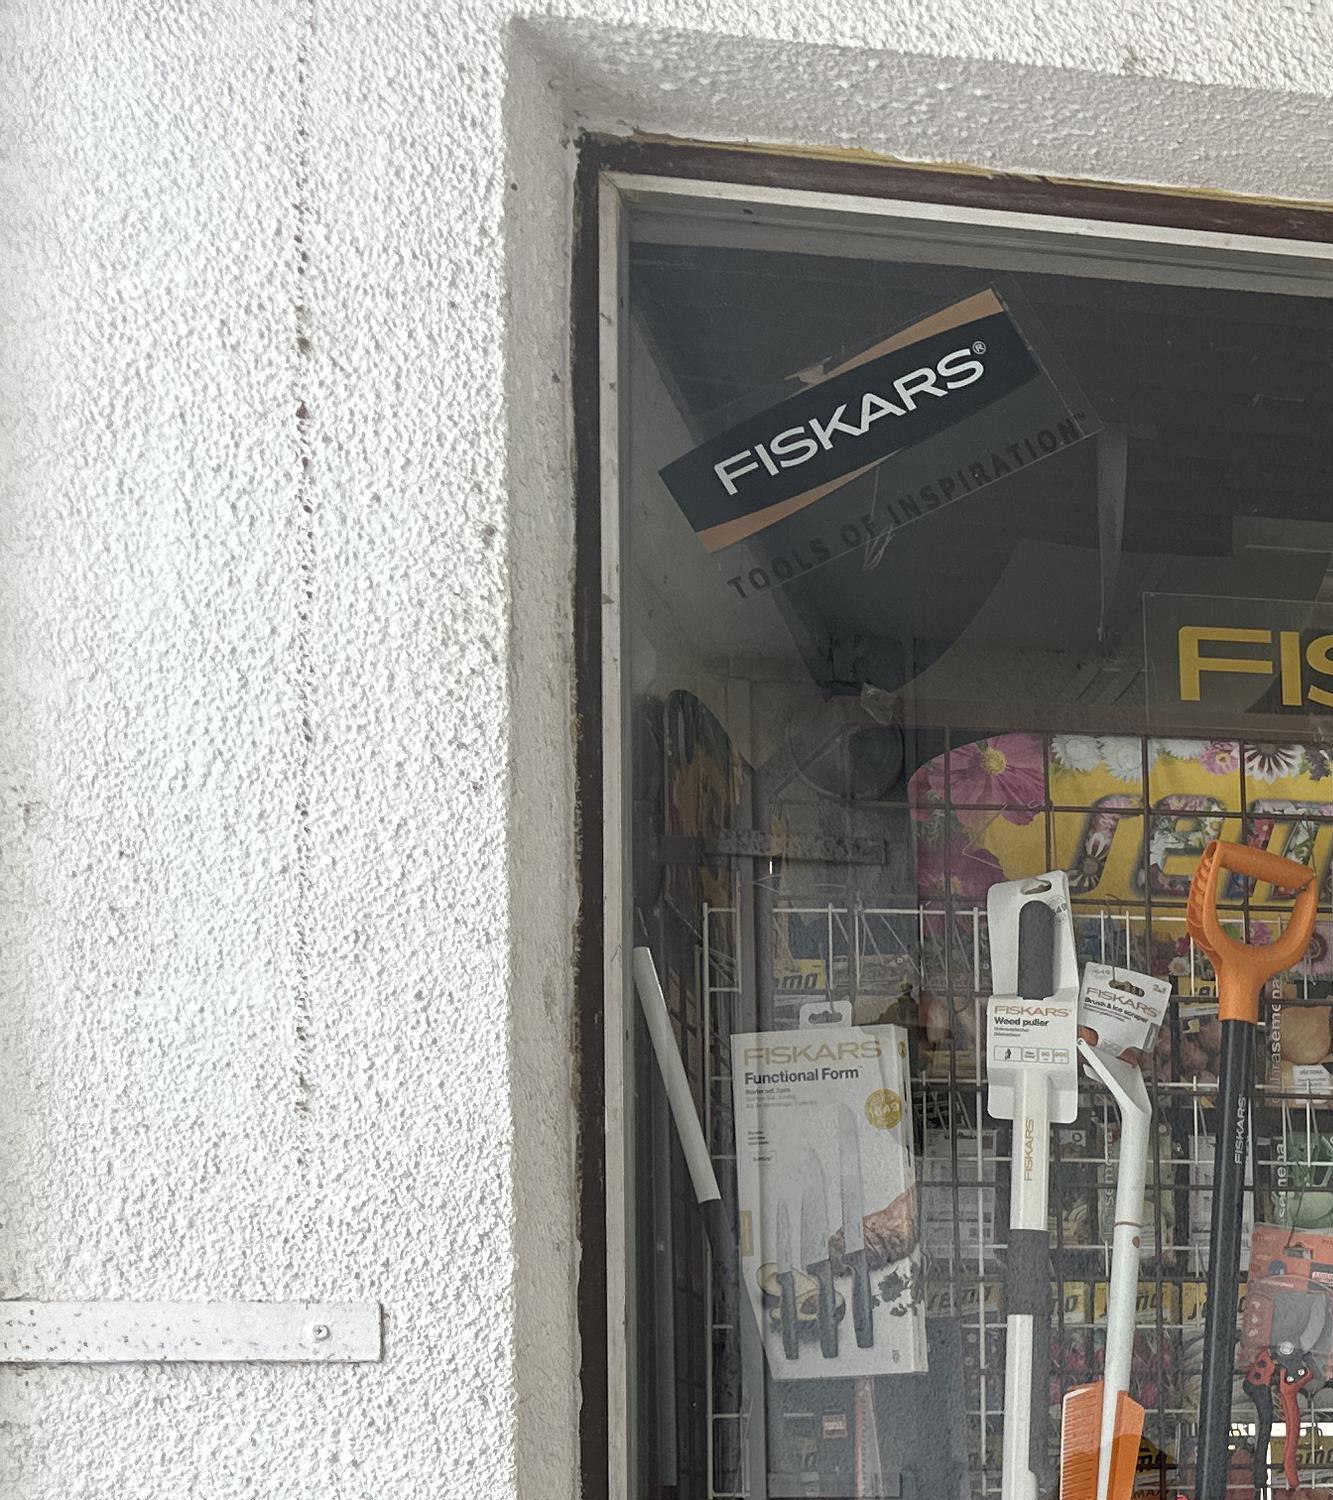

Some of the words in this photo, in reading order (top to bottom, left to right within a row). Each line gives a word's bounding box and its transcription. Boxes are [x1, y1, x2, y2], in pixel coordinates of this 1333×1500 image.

[727, 535, 830, 600] TOOLS
[842, 511, 880, 547] OF
[994, 1006, 1069, 1017] FISKARS
[1085, 987, 1157, 1018] FISKARS
[994, 1017, 1020, 1026] Weed
[743, 1040, 881, 1066] FISKARS
[744, 1069, 818, 1087] Functional
[820, 1067, 859, 1081] Form
[1234, 1095, 1246, 1165] FISKARS
[1024, 1117, 1034, 1181] FISKARS
